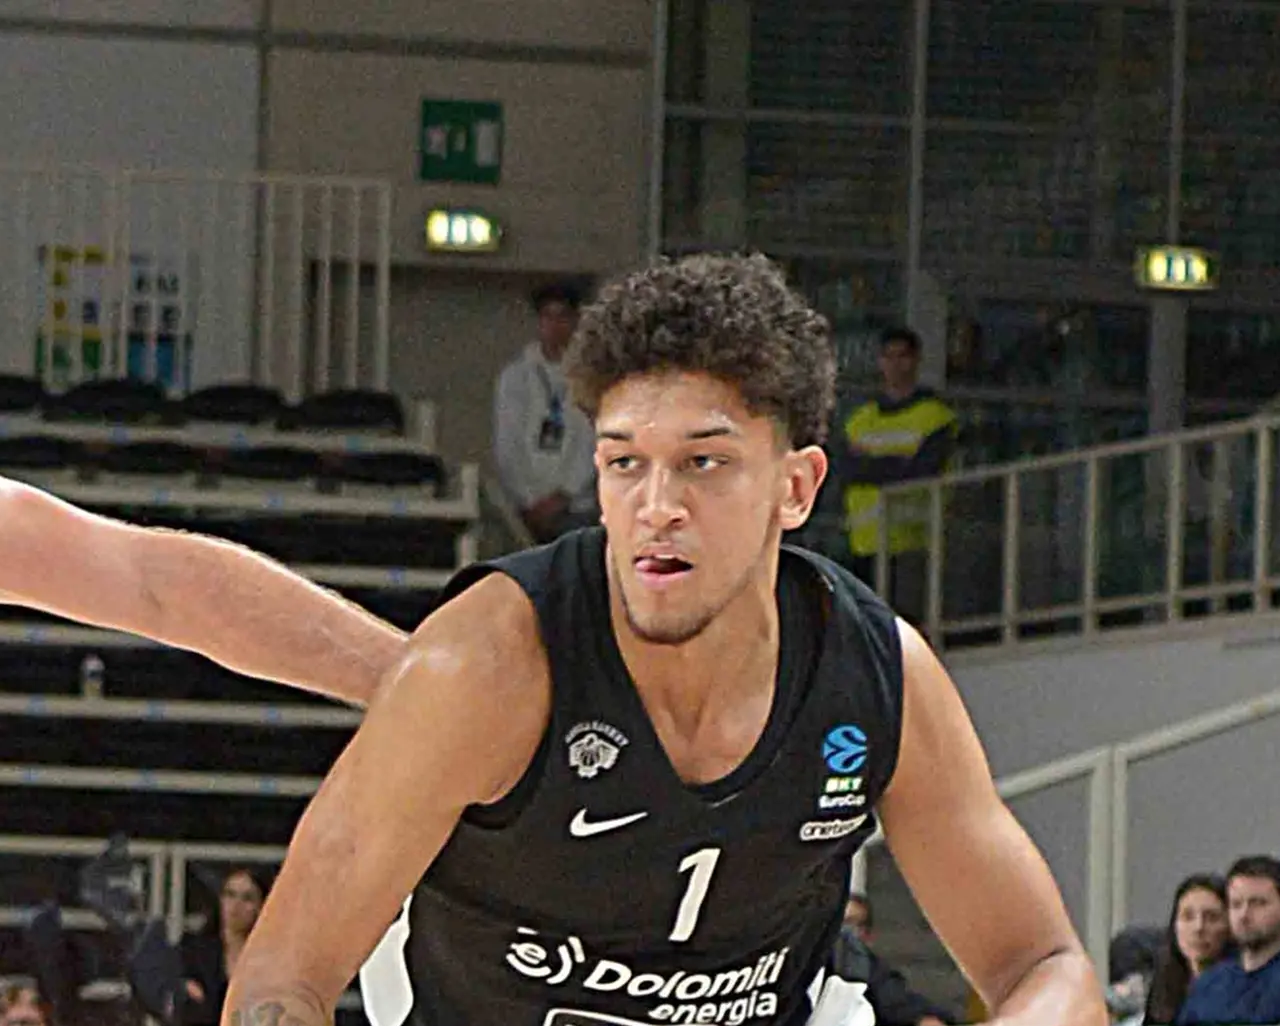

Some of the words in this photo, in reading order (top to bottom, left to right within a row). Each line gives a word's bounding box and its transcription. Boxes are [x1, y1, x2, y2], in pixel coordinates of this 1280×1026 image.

[667, 847, 722, 942] 1
[583, 946, 790, 1000] Dolomiti
[648, 991, 778, 1026] energia
